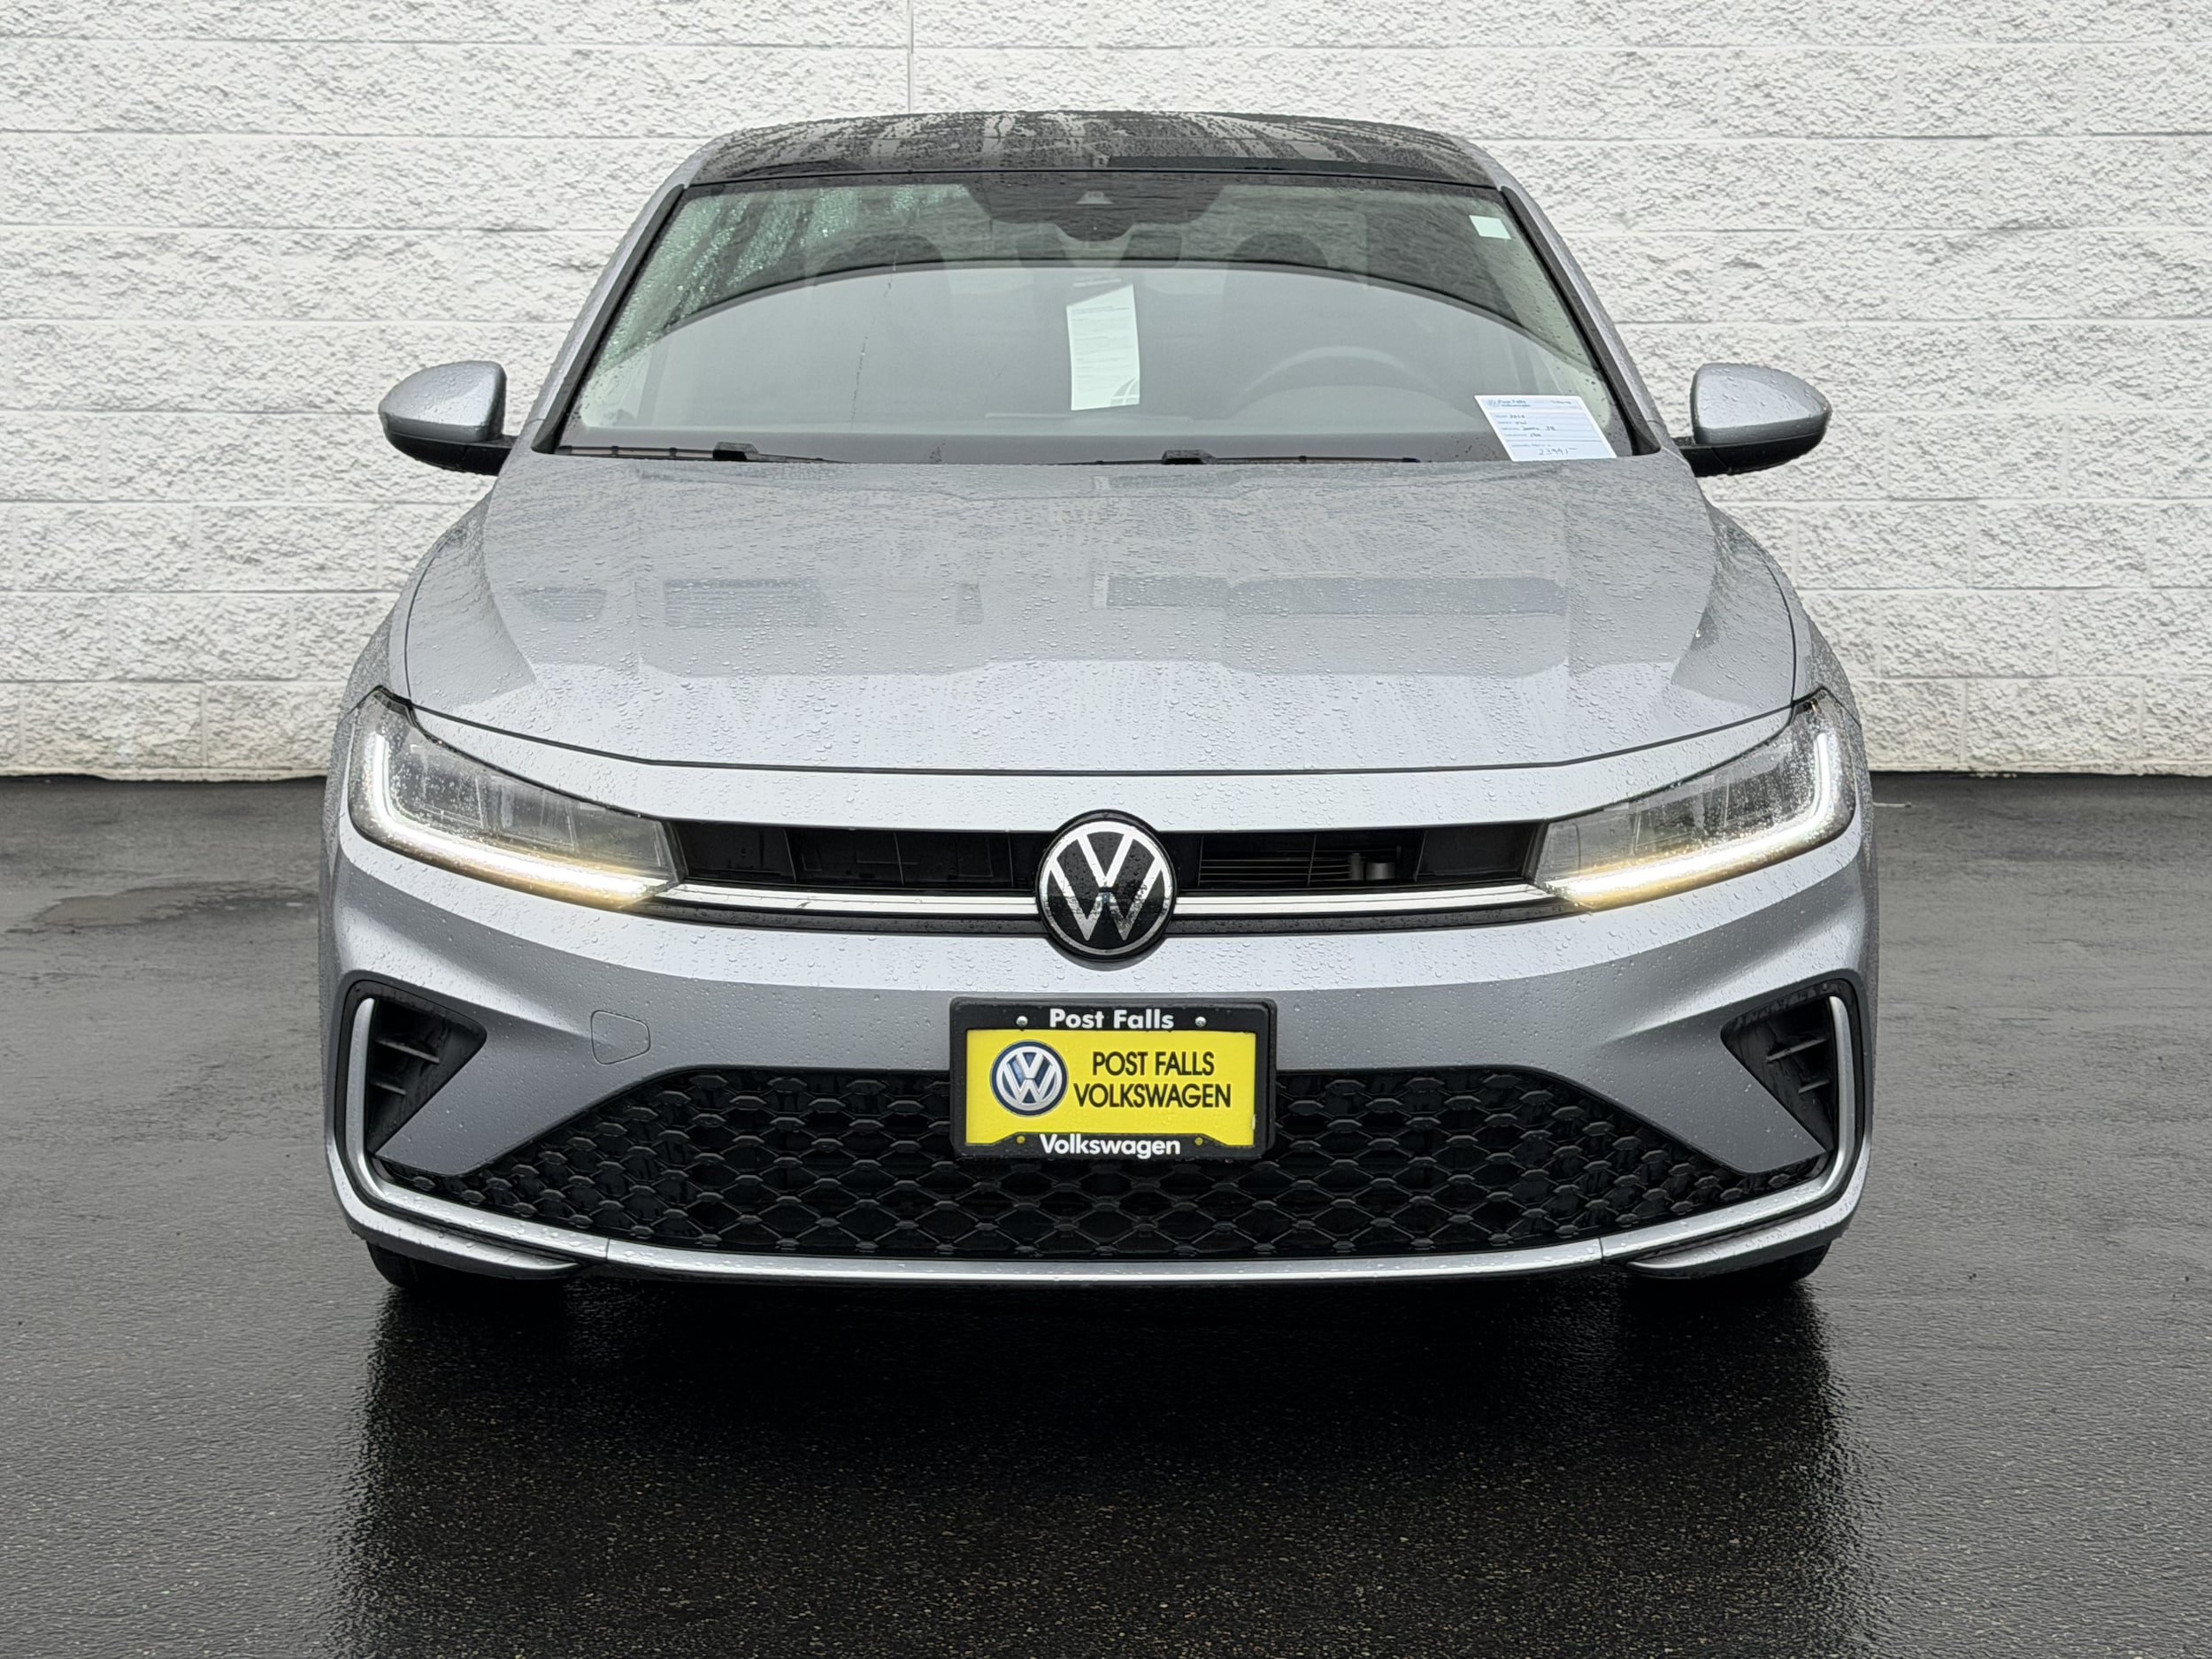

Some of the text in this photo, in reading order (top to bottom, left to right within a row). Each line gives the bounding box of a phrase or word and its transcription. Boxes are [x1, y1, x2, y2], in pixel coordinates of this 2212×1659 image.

[1044, 826, 1168, 948] VW
[1049, 1008, 1175, 1030] Post Falls
[1092, 1051, 1215, 1076] POST FALLS
[994, 1044, 1064, 1113] VW
[1073, 1083, 1232, 1108] VOLKSWAGEN
[1039, 1133, 1181, 1159] Volkswagen
